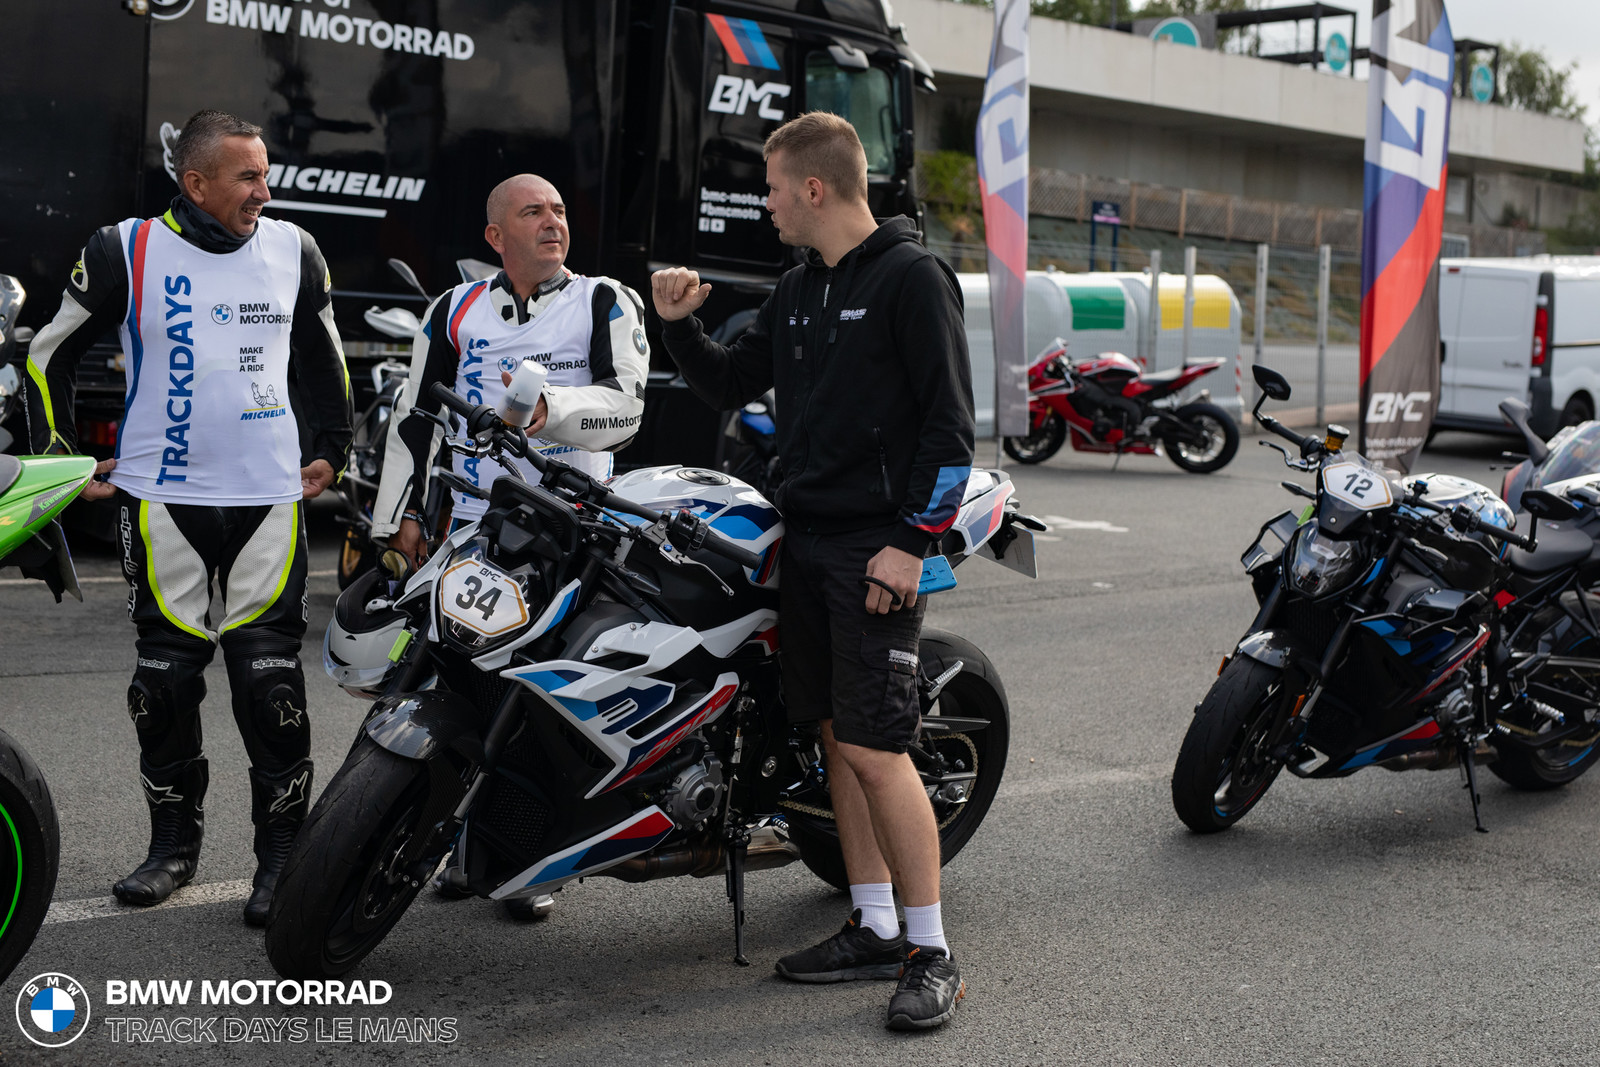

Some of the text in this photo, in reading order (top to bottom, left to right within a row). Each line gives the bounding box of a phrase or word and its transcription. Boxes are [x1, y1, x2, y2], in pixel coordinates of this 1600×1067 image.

[206, 0, 475, 61] BMW MOTORRAD
[708, 74, 791, 121] BMC
[239, 303, 270, 313] BMW
[239, 346, 264, 355] MAKE
[239, 355, 257, 363] LIFE
[542, 359, 587, 372] TORRAD
[239, 364, 265, 372] A RIDE
[155, 274, 195, 486] TRACKDAYS
[240, 408, 286, 421] MICHELIN
[1366, 391, 1431, 423] BMC
[580, 414, 642, 430] BMW Motorr
[1343, 473, 1374, 499] 12
[38, 485, 71, 511] Kawasaki
[479, 567, 502, 582] BMC
[455, 575, 503, 621] 34
